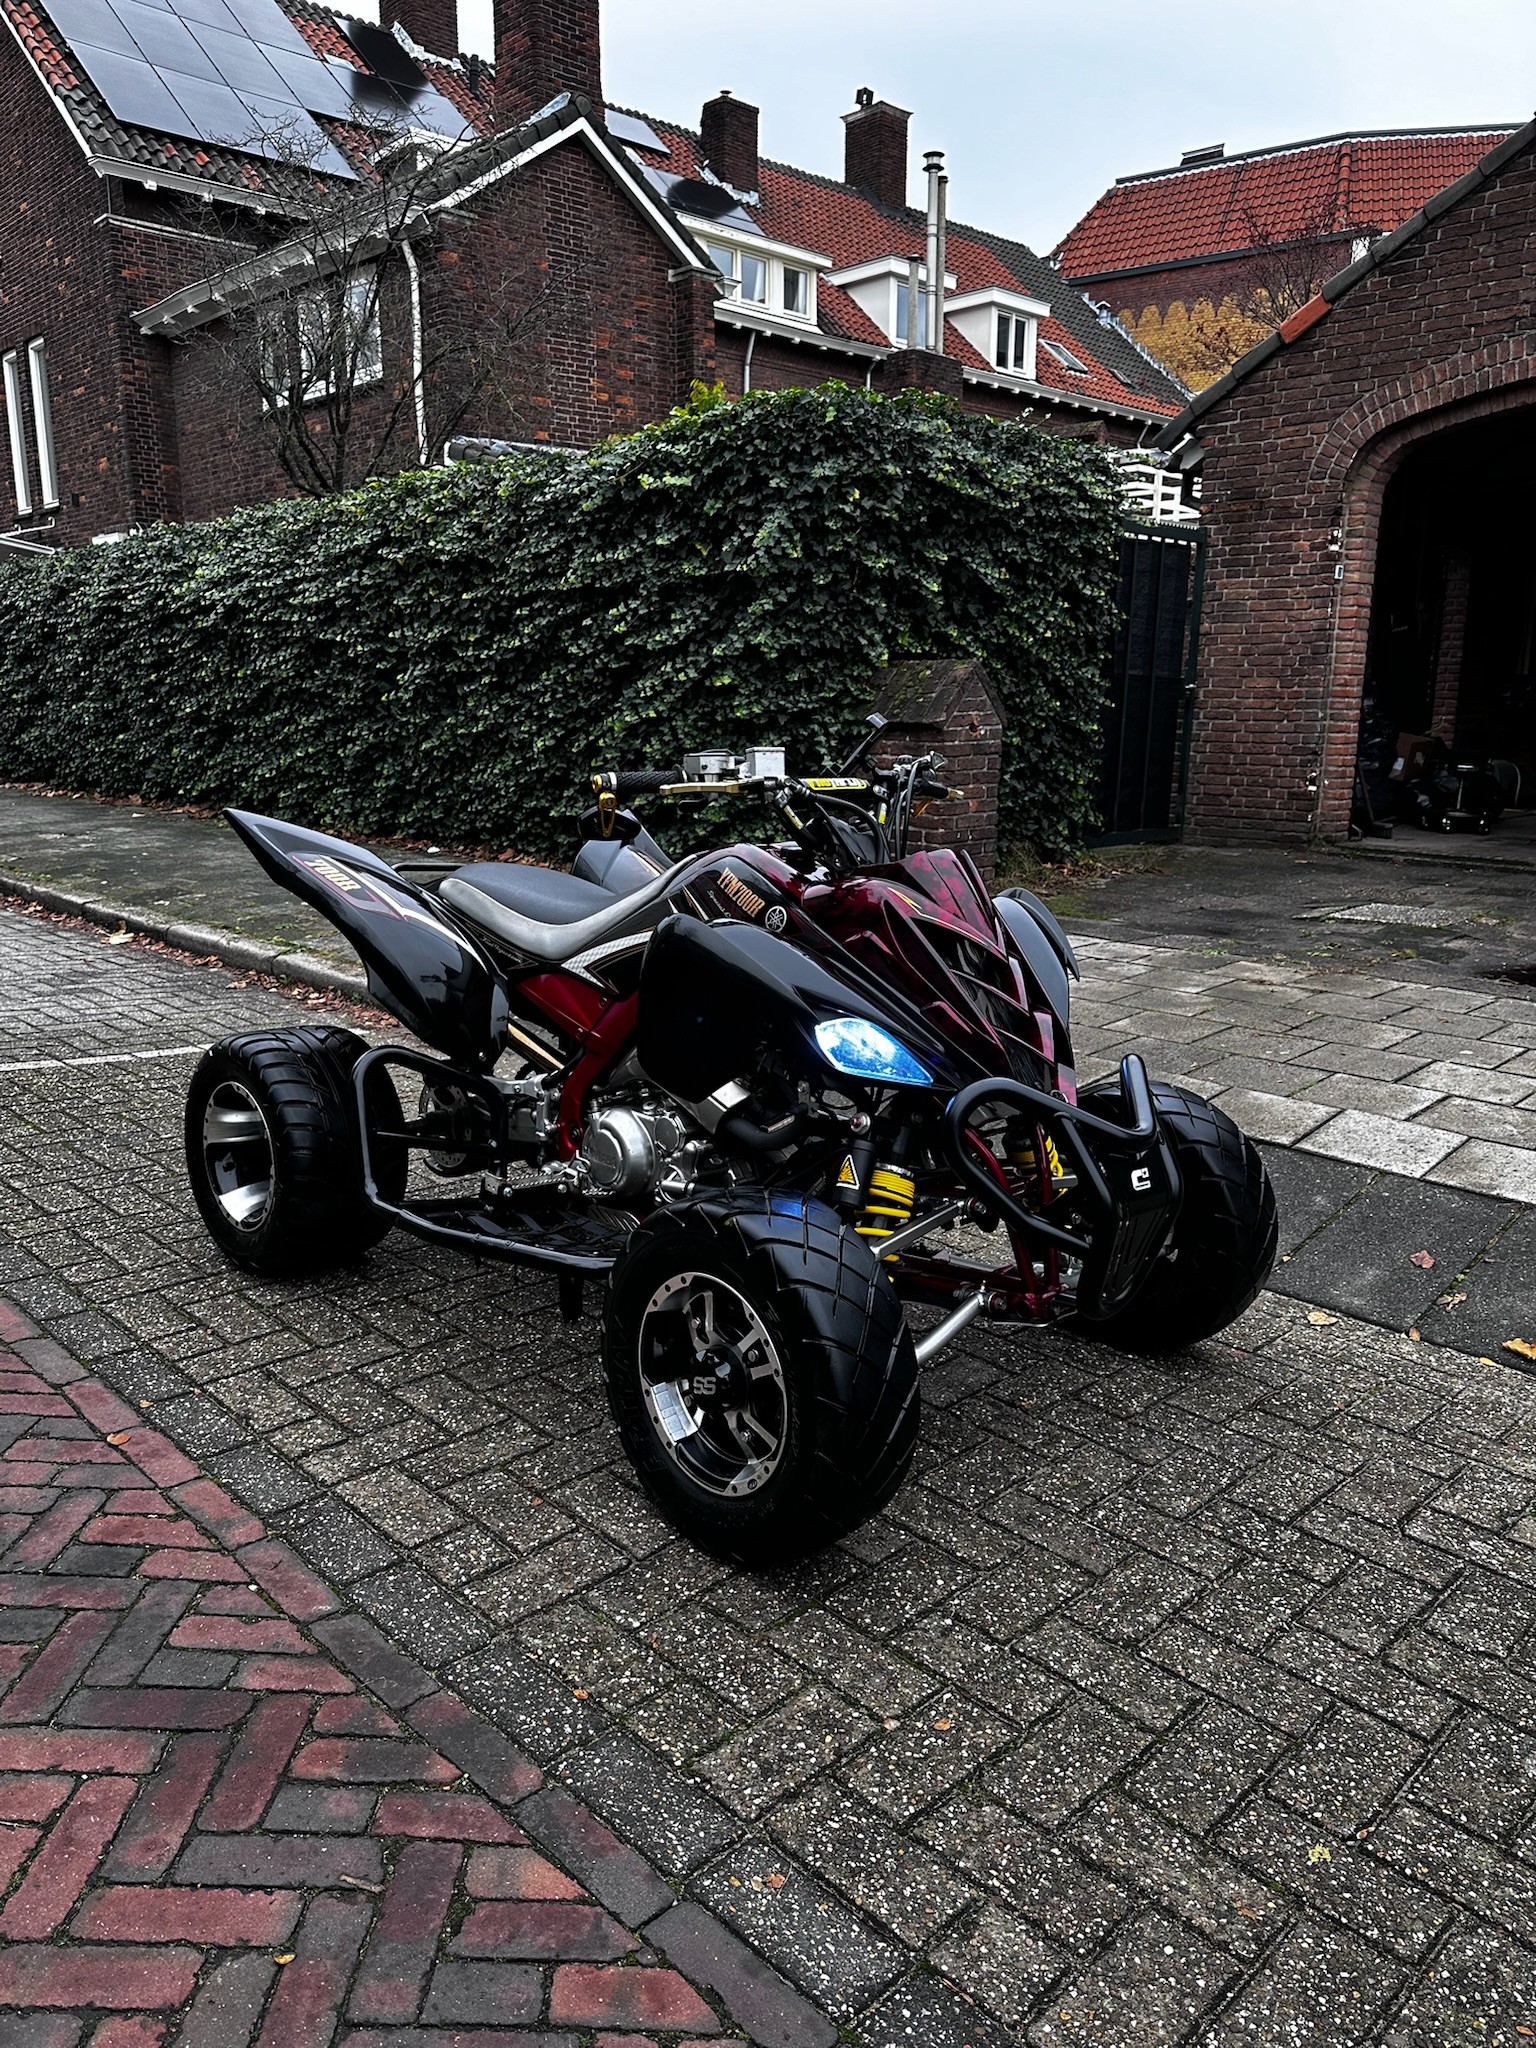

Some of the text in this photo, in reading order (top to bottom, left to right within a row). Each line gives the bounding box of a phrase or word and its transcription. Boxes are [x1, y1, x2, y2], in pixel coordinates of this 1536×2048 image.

[303, 859, 362, 892] 700R
[717, 867, 766, 918] YFM700R
[693, 1376, 717, 1395] SS
